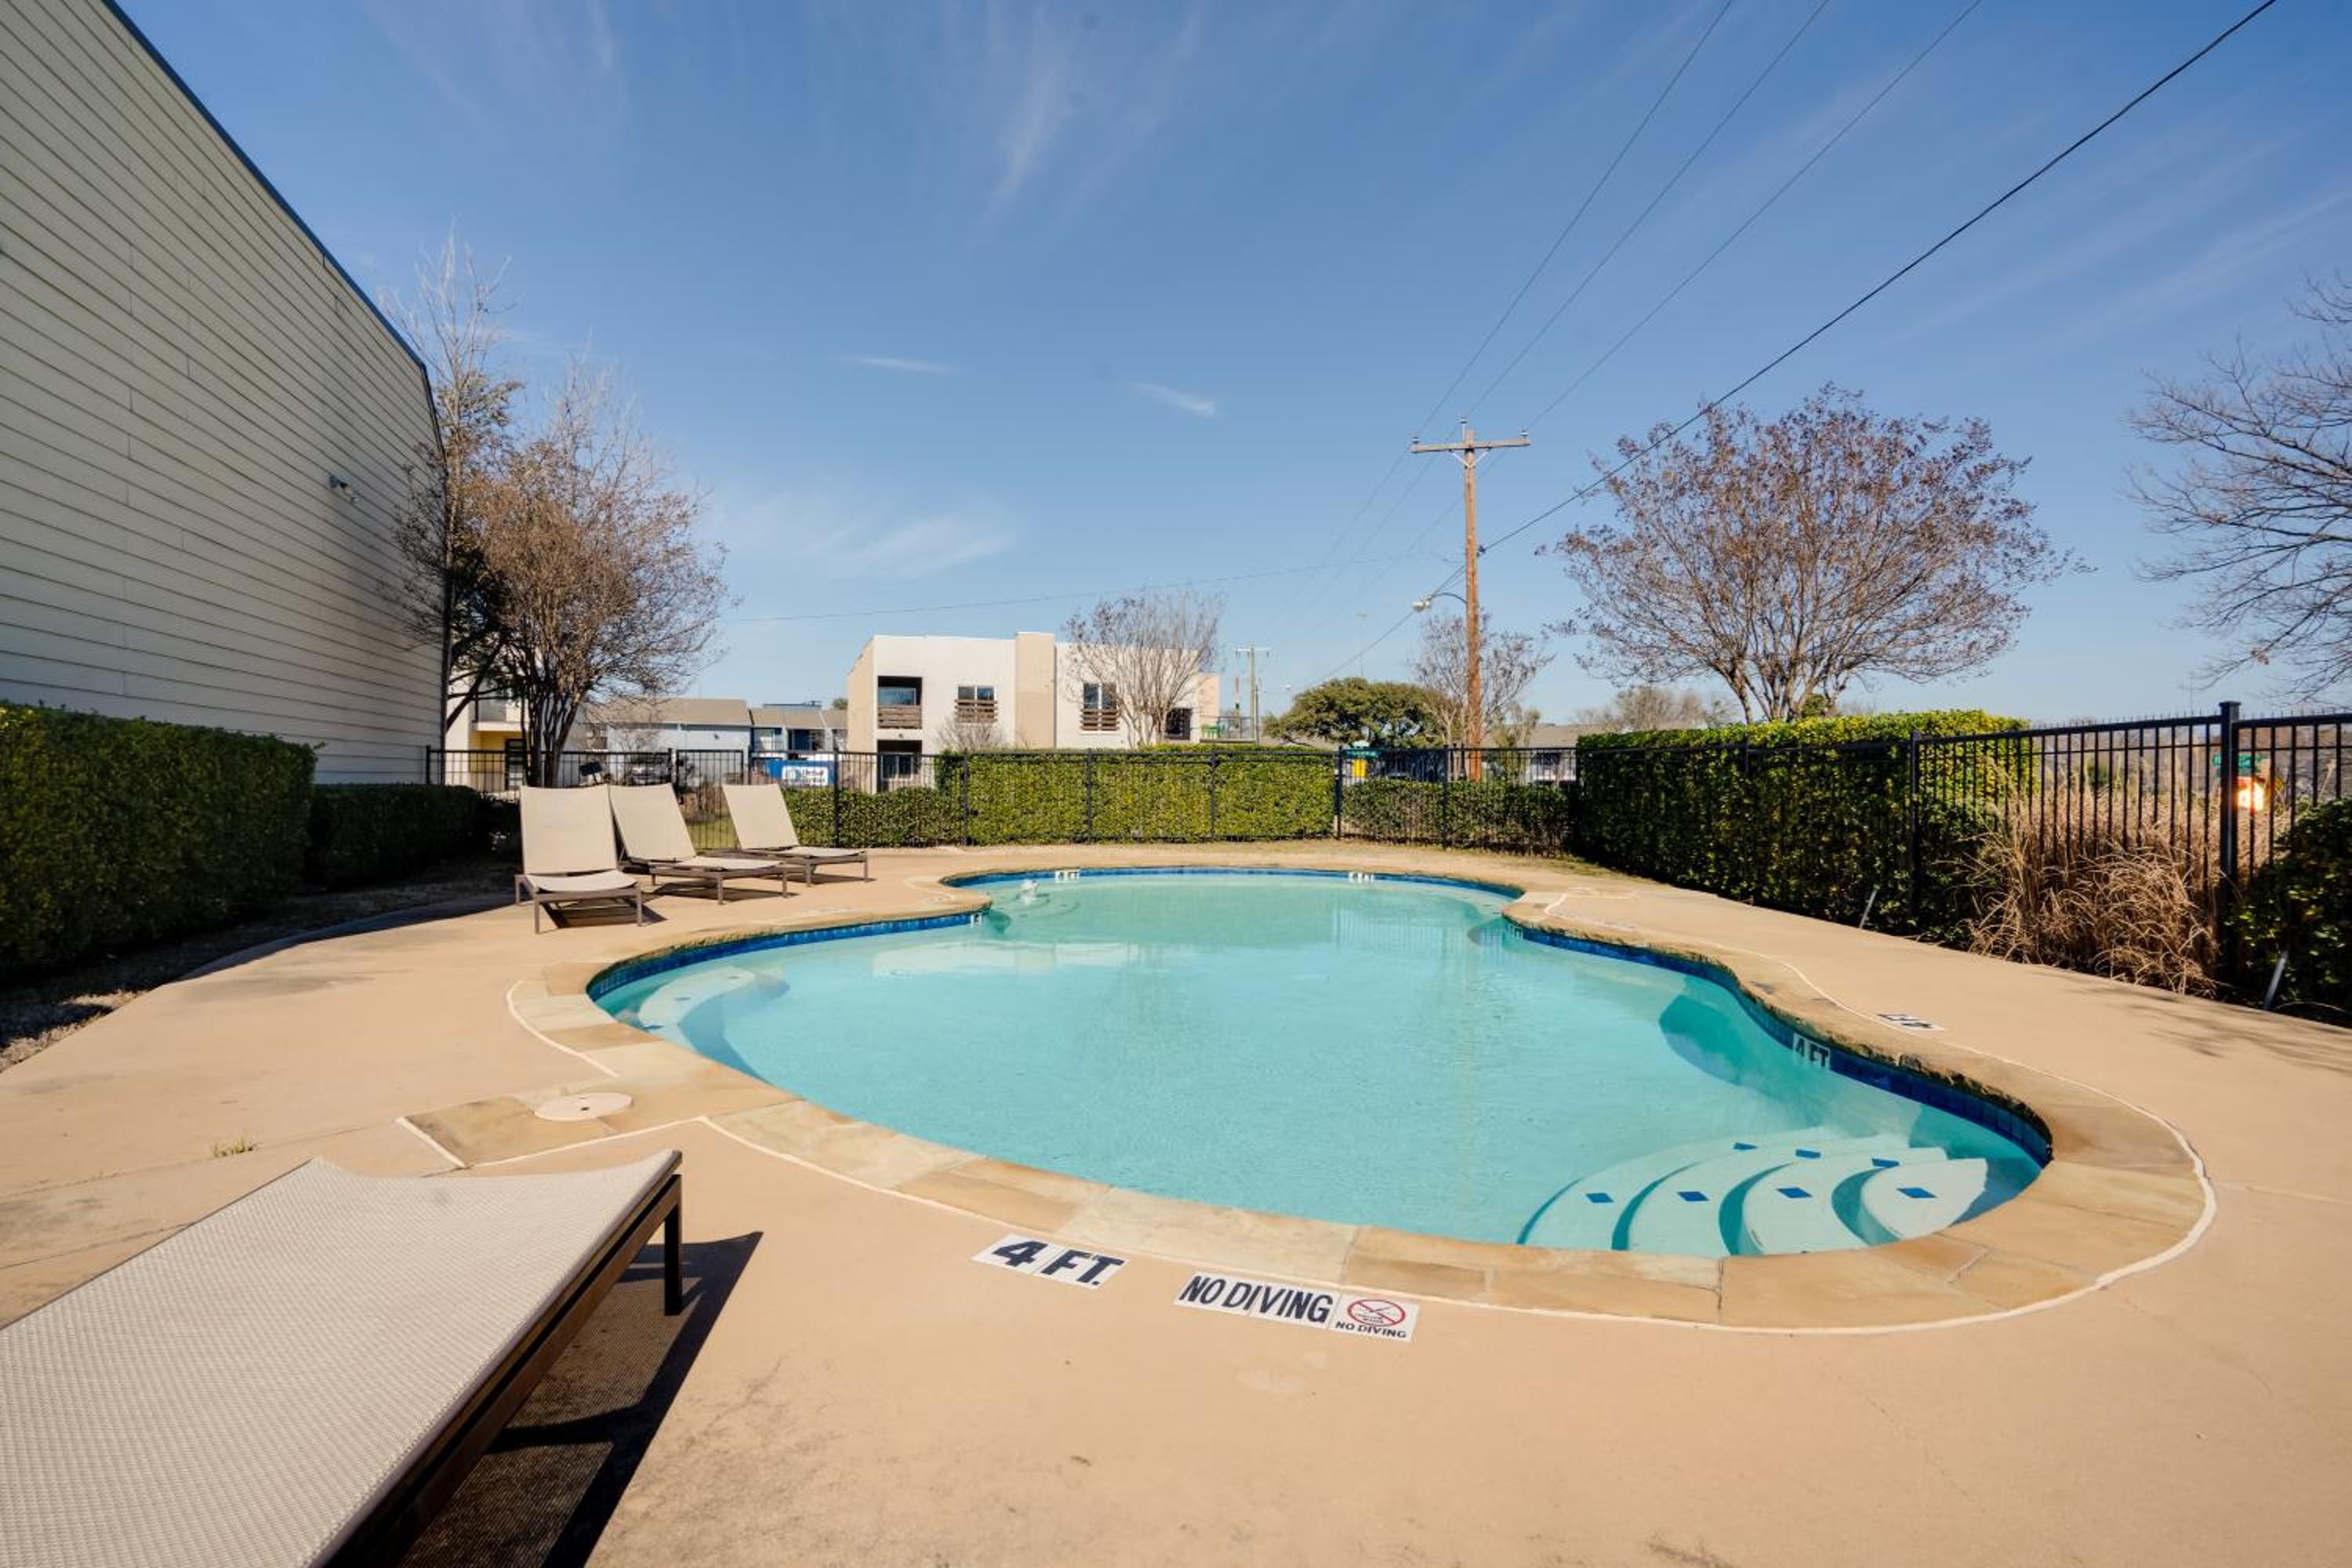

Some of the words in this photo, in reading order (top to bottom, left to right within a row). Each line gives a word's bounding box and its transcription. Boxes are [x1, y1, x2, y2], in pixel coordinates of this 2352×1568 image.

[991, 1240, 1048, 1267] 4
[1040, 1249, 1126, 1286] FT.
[1178, 1276, 1227, 1305] NO
[1221, 1282, 1334, 1323] DIVING
[1335, 1321, 1355, 1330] NO
[1357, 1324, 1406, 1338] DIVING
